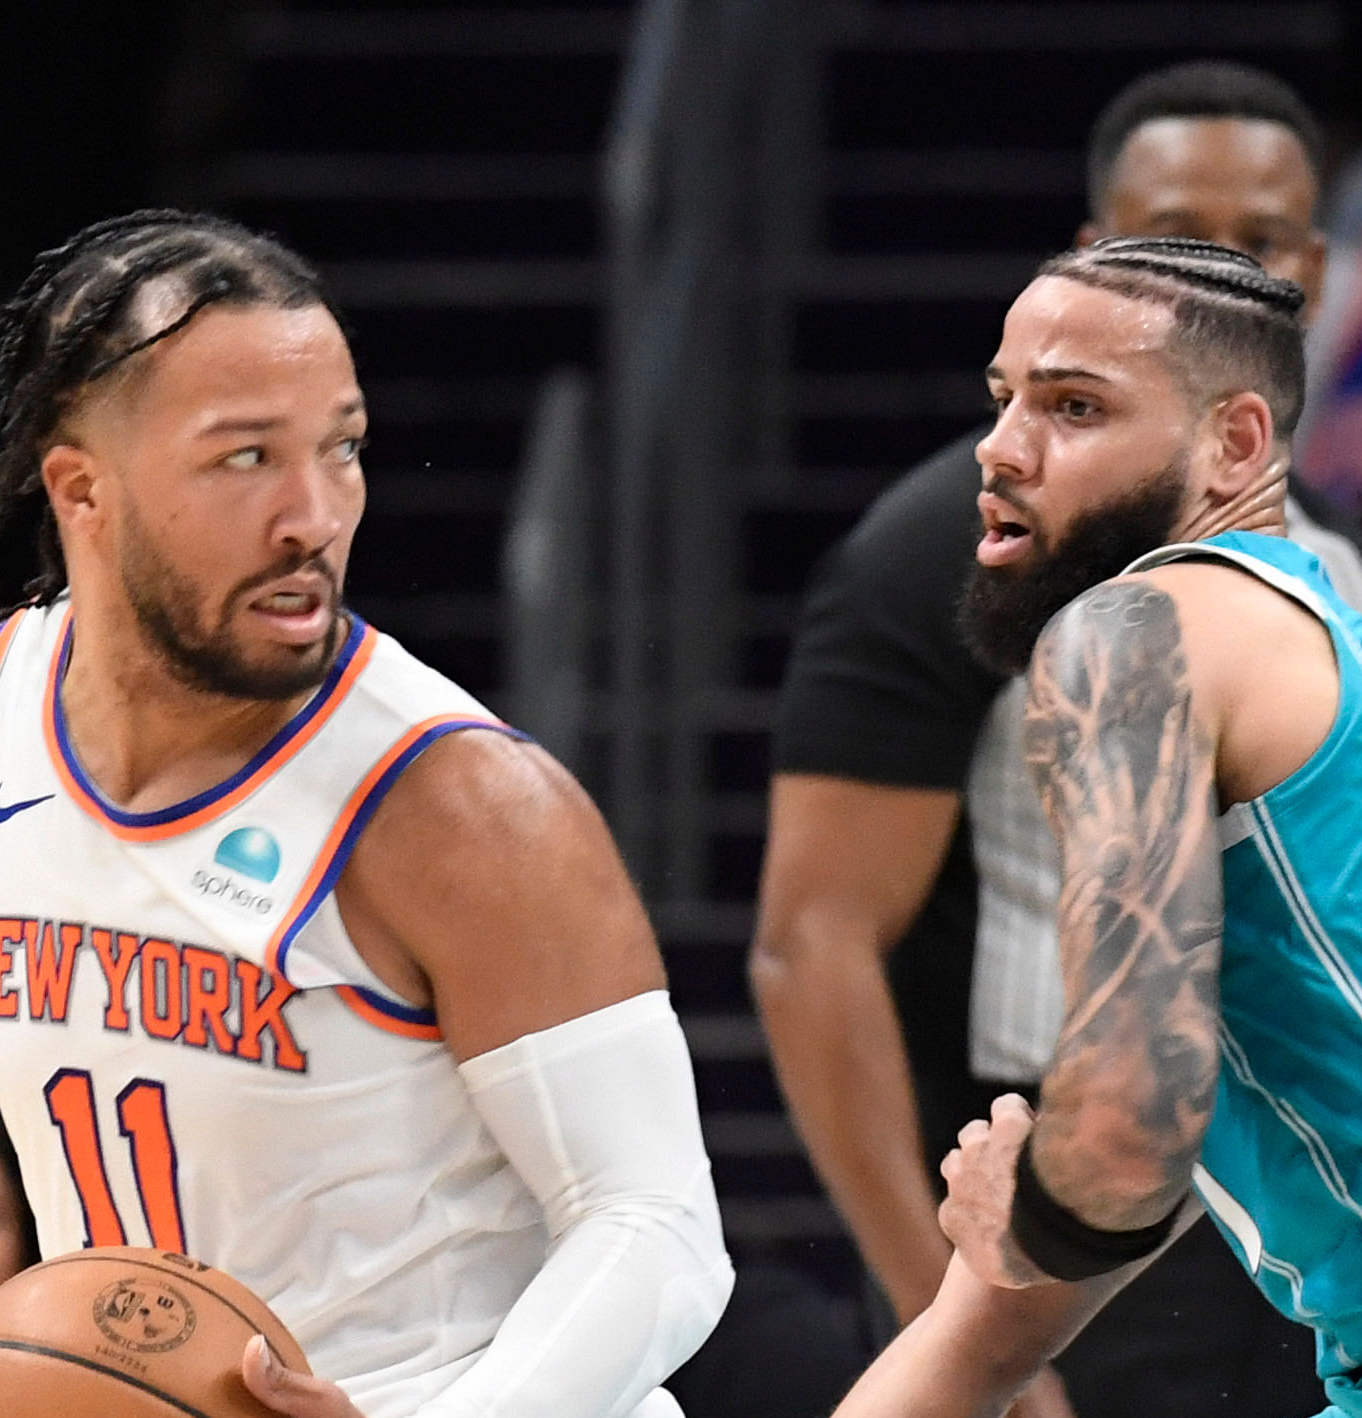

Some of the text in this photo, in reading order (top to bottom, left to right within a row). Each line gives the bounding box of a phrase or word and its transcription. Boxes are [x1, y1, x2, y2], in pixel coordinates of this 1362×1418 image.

[191, 869, 273, 915] sphere
[91, 927, 308, 1074] YORK
[43, 1067, 187, 1256] 11
